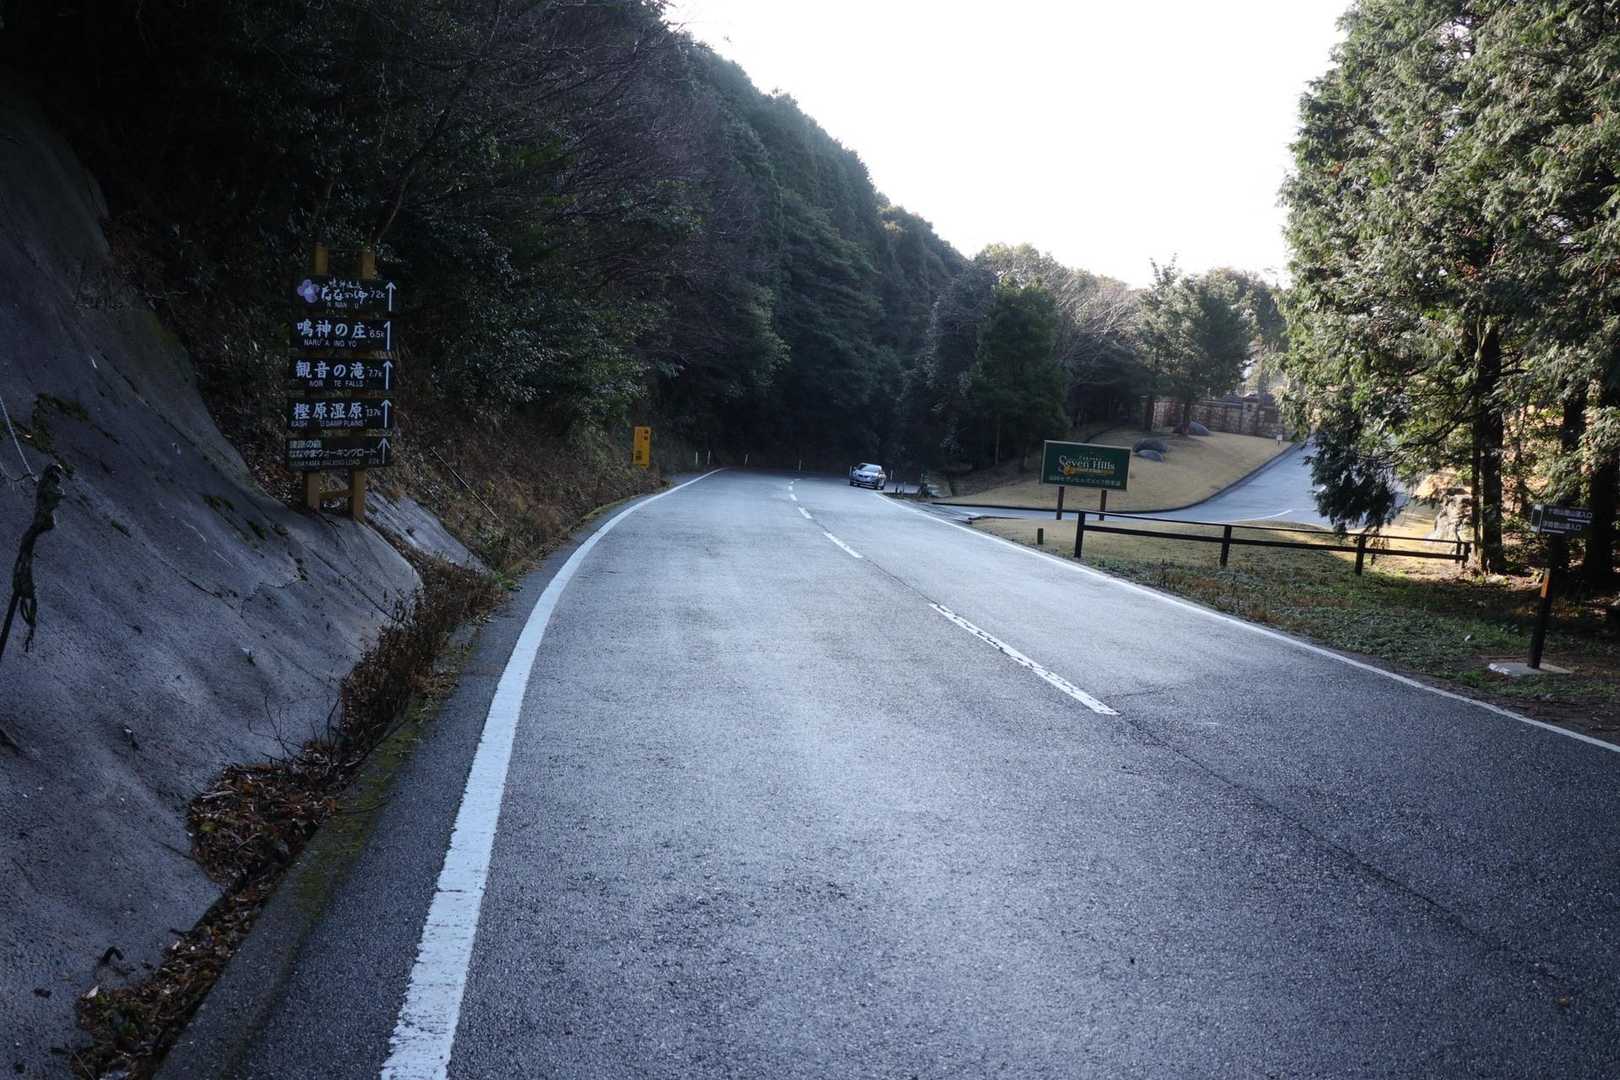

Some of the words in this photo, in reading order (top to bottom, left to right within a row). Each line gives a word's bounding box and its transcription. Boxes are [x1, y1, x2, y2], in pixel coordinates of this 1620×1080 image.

[296, 318, 367, 338] 鳴神の庄
[295, 359, 365, 380] 観音の滝
[1059, 455, 1088, 469] Seven
[1092, 459, 1116, 470] Hills
